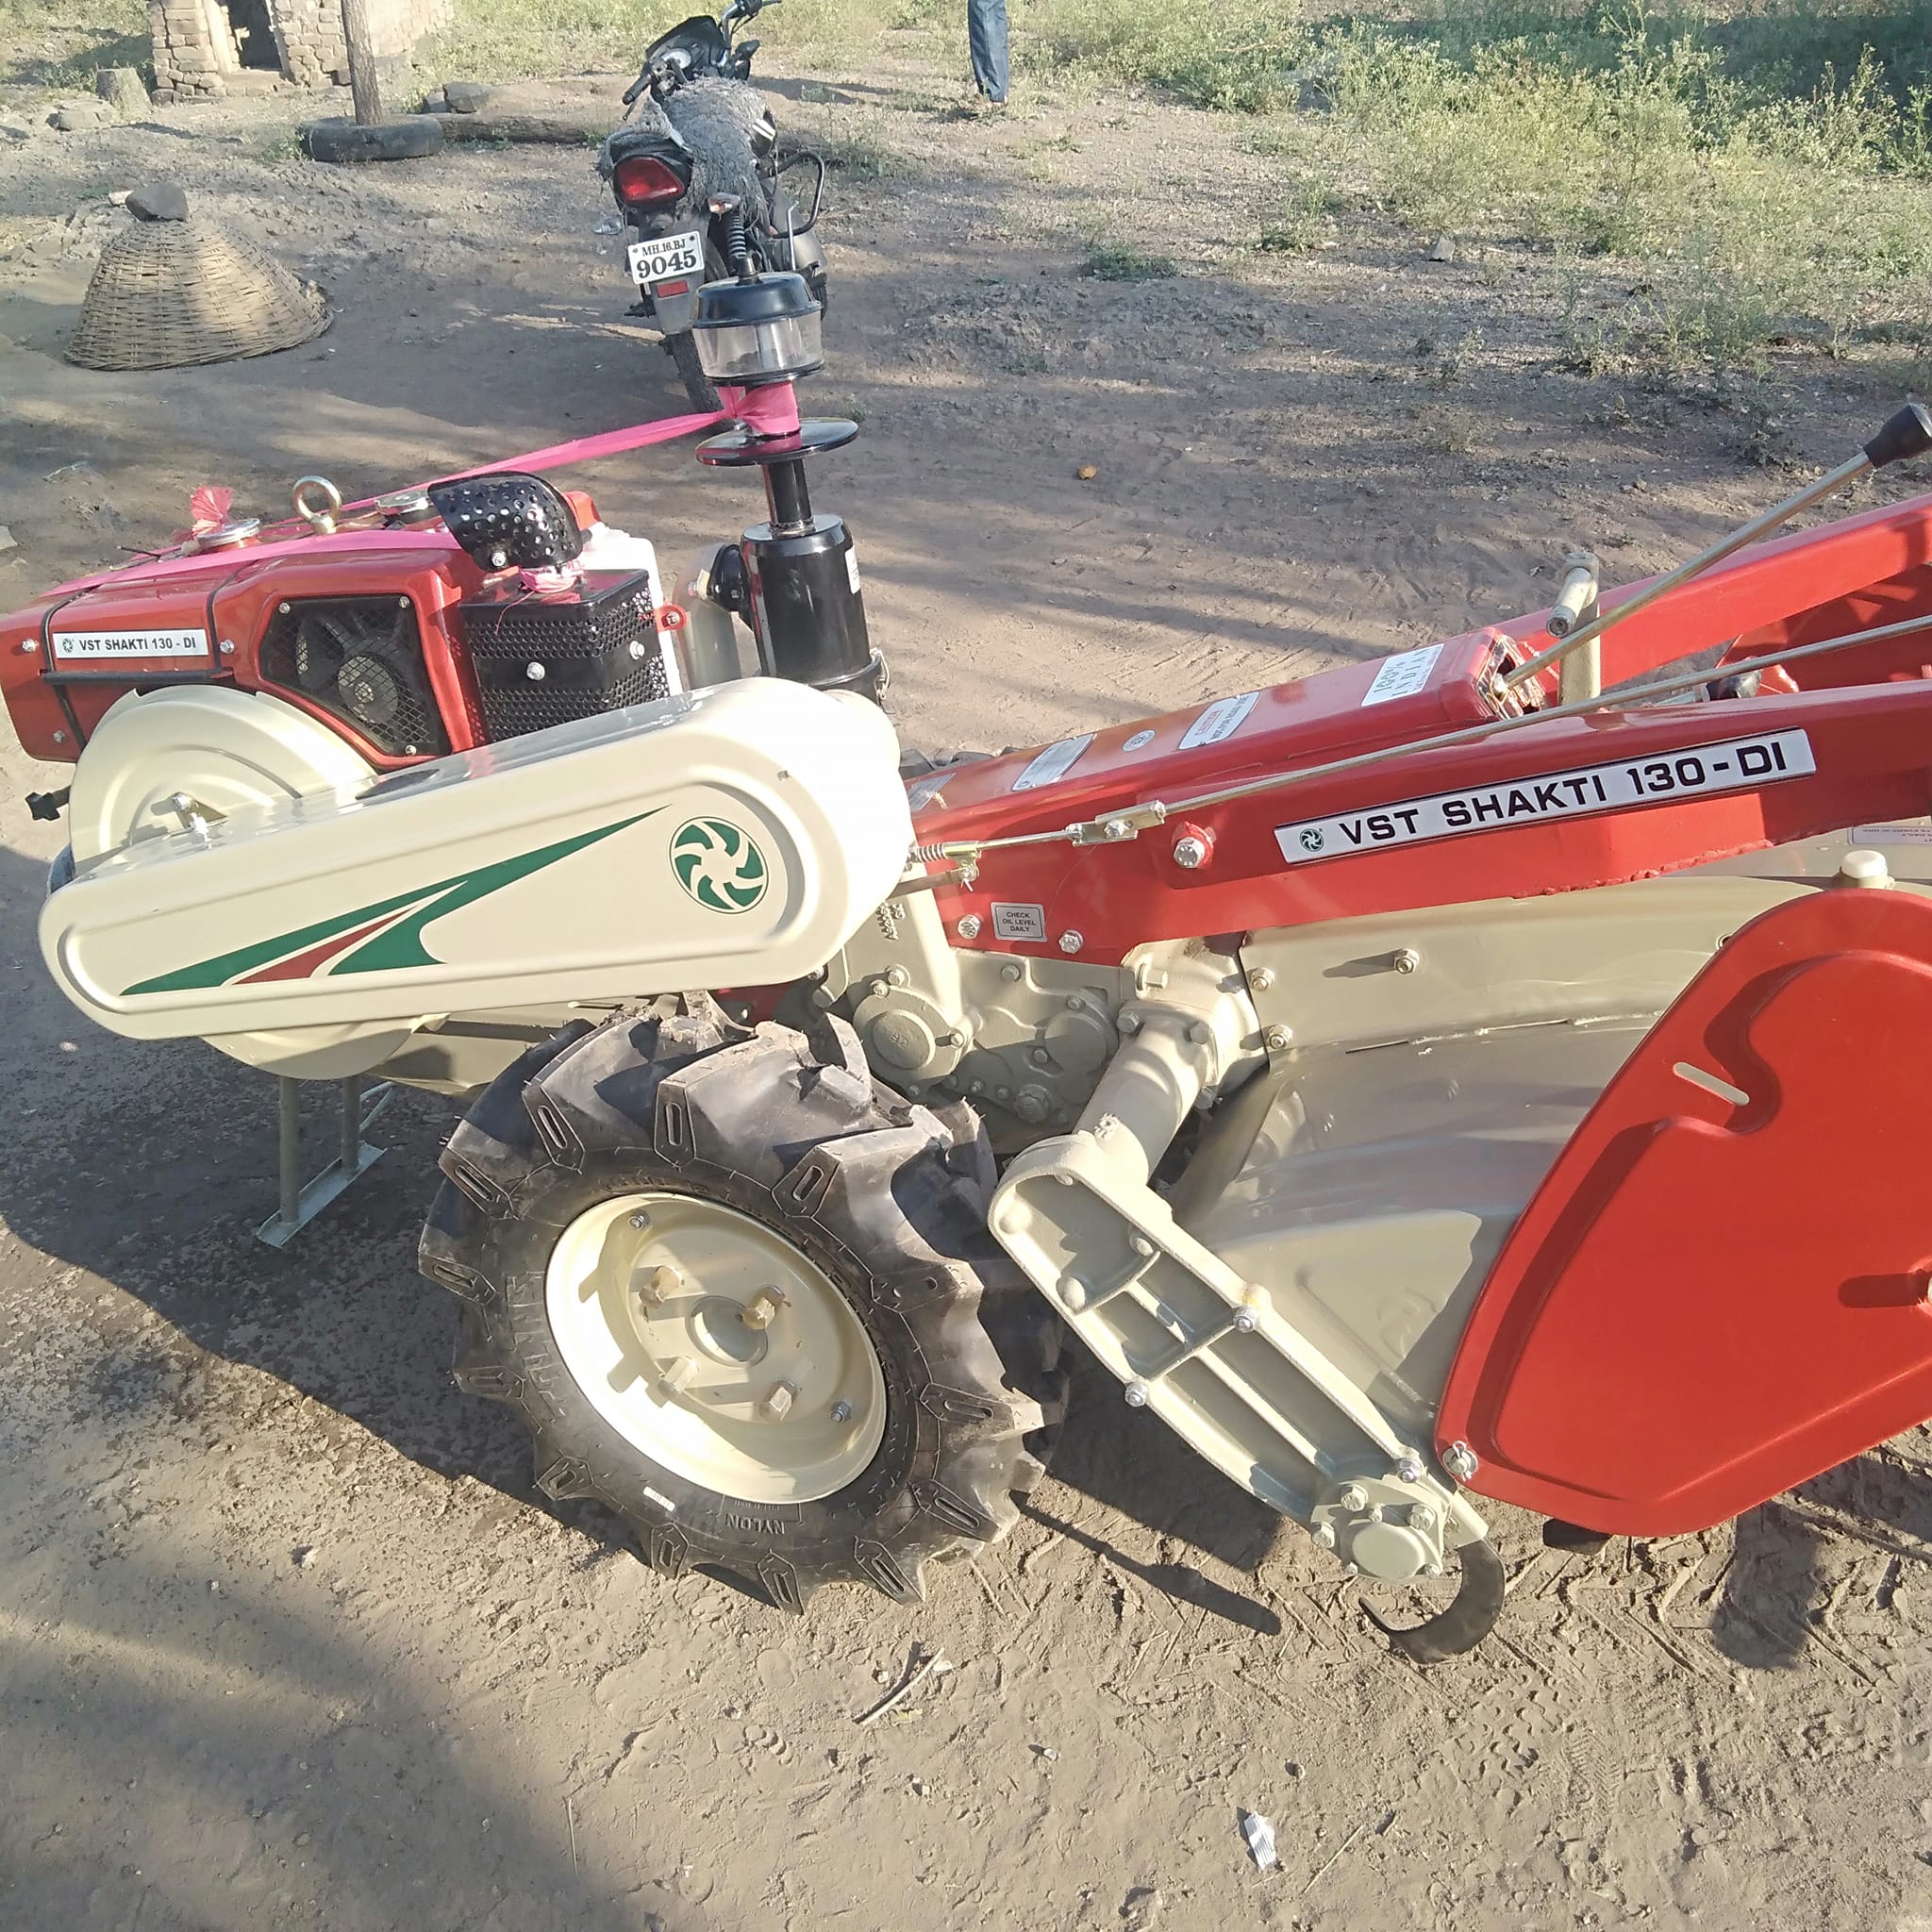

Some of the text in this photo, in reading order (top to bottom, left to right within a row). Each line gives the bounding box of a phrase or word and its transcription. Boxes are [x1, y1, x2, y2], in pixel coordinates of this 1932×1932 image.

[636, 249, 696, 278] 9045
[78, 639, 101, 651] VST
[105, 638, 148, 651] SHAKTI
[151, 637, 173, 650] 130
[183, 637, 196, 649] DI
[1339, 808, 1419, 845] VST
[1442, 774, 1607, 828] SHAKTI
[724, 1512, 785, 1535] NYLON
